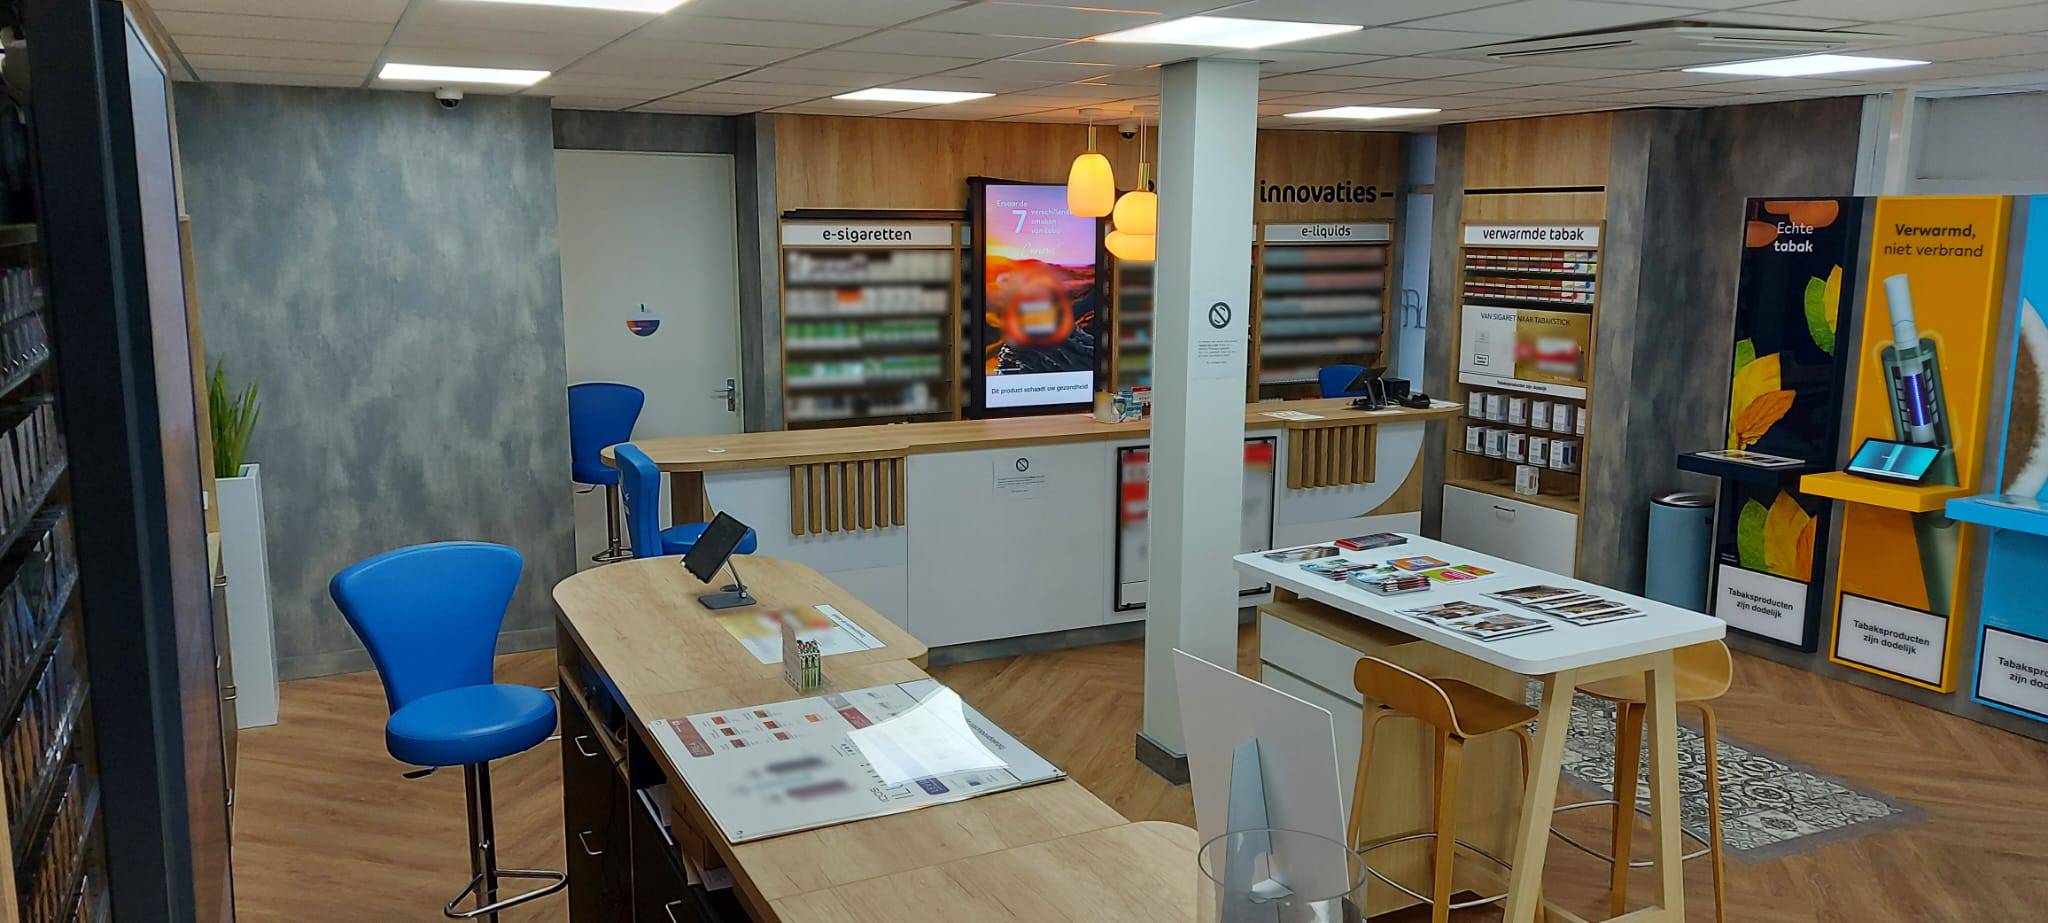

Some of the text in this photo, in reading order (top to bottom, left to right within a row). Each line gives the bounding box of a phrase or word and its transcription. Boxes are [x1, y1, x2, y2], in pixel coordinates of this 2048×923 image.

[1260, 180, 1377, 203] innovaties
[1012, 209, 1027, 234] 7
[1777, 221, 1814, 235] Echte
[823, 227, 912, 243] e-sigaretten
[1302, 225, 1352, 239] e-liquids
[1483, 227, 1585, 241] verwarmde tabak
[1895, 224, 1977, 240] Verwarmd,
[1774, 239, 1813, 253] tabak
[1884, 242, 1984, 258] niet verbrand
[1001, 387, 1023, 395] product
[1728, 587, 1794, 611] Tabaksproducten
[1736, 599, 1782, 619] zijn dodelijk
[1853, 619, 1930, 646] Tabaksproducten
[1863, 635, 1917, 655] zijn dodelijk
[2009, 672, 2028, 684] zijn
